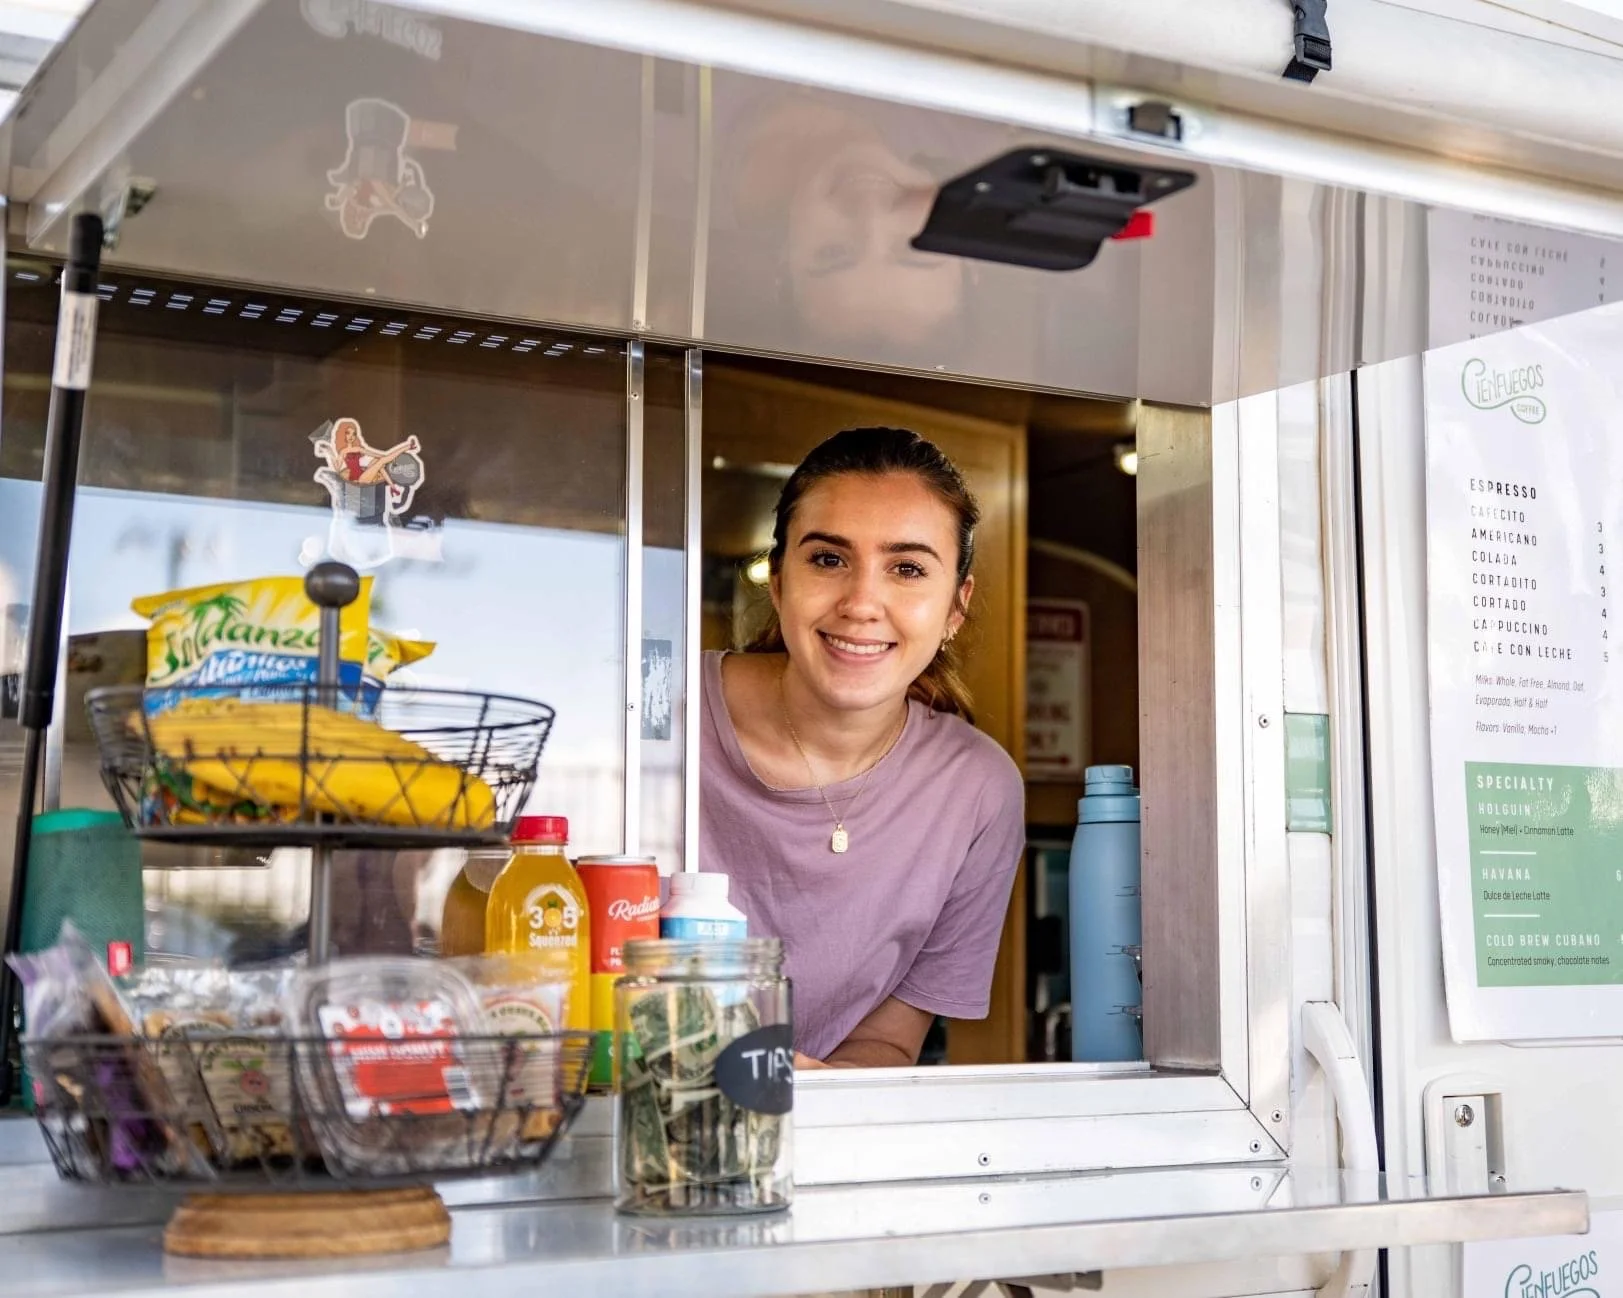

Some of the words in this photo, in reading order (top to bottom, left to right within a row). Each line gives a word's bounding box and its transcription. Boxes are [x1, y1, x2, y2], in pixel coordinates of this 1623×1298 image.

[1461, 358, 1544, 410] CIENFUEGOS
[1470, 478, 1537, 500] ESPRESSO
[1471, 505, 1525, 523] CAFECITO
[1597, 521, 1603, 533] 3
[1471, 528, 1537, 546] AMERICANO
[1598, 543, 1604, 554] 3
[1472, 550, 1517, 566] COLADA
[1599, 565, 1605, 575] 4
[1472, 573, 1537, 590] CORTADITO
[1600, 587, 1606, 598] 3
[1473, 595, 1526, 612] CORTADO
[1601, 608, 1607, 618] 4
[1602, 630, 1608, 641] 4
[1510, 643, 1531, 657] CON
[1538, 646, 1573, 660] LECHE
[1518, 677, 1529, 687] Fat
[1514, 697, 1527, 707] Half
[1535, 698, 1548, 709] Half
[1528, 724, 1549, 735] Mocha
[1476, 774, 1554, 792] SPECIALTY
[1478, 802, 1532, 817] HOLGUIN
[1479, 824, 1500, 836] Honey
[1523, 825, 1556, 836] Cinnamon
[1557, 826, 1575, 836] Latte
[1482, 867, 1532, 881] HAVANA
[1483, 890, 1502, 901] Dulce
[1502, 890, 1511, 901] de
[1512, 890, 1532, 901] Leche
[1532, 891, 1551, 901] Latte
[1486, 934, 1514, 948] COLD
[1519, 934, 1550, 947] BREW
[1555, 933, 1601, 947] CUBANO
[1487, 956, 1532, 967] Concentrated
[1557, 955, 1590, 966] chocolate
[1590, 954, 1610, 966] notes
